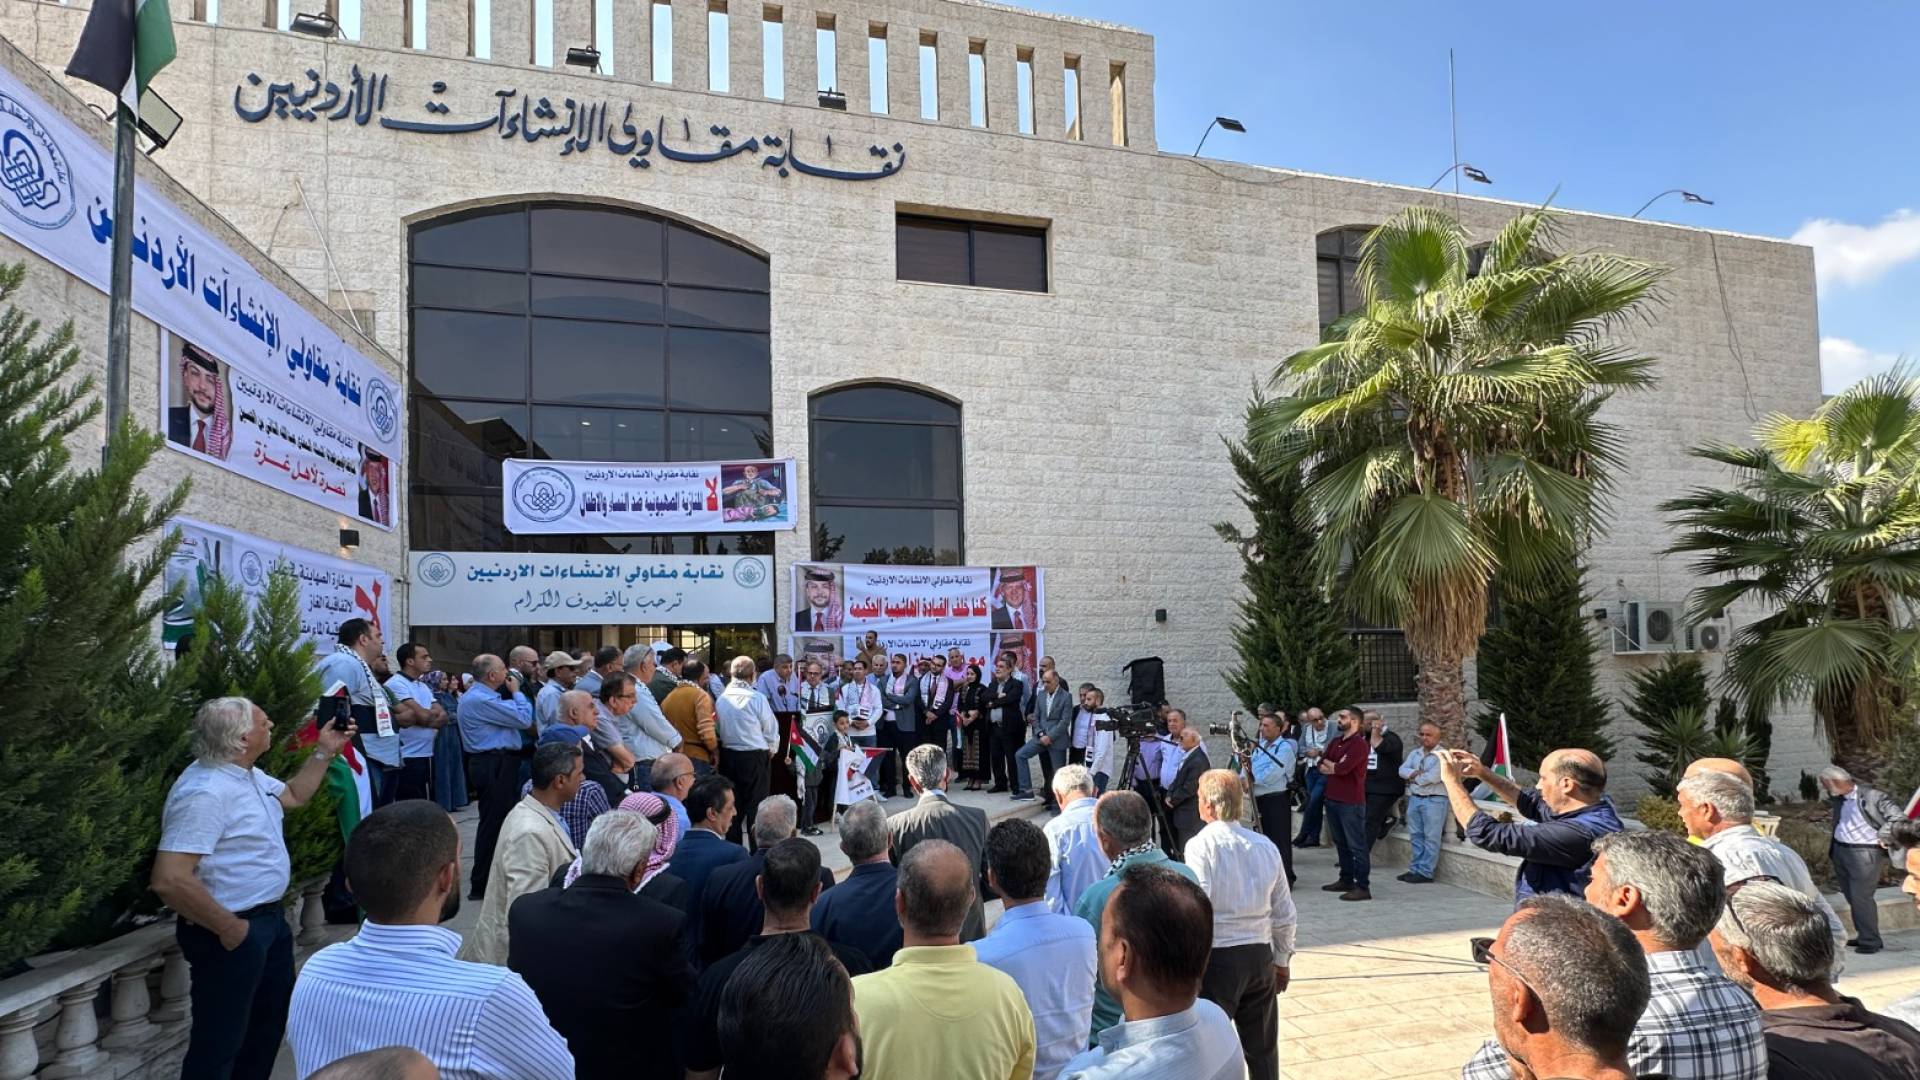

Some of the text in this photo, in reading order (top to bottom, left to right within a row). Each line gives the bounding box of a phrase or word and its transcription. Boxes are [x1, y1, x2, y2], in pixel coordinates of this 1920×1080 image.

[234, 63, 388, 126] الأردنيين
[607, 100, 760, 169] مقاولي
[761, 131, 905, 181] نقابة
[86, 196, 195, 295] الأردنن
[285, 335, 332, 387] مقاولي
[334, 358, 362, 408] نقابة
[319, 471, 346, 497] نصرة
[467, 562, 535, 582] الاردنيين
[540, 559, 620, 579] الانشاءات
[624, 562, 679, 589] مقاولي
[682, 562, 724, 584] نقابة
[514, 588, 683, 614] ترحب بالضيوف الكرام
